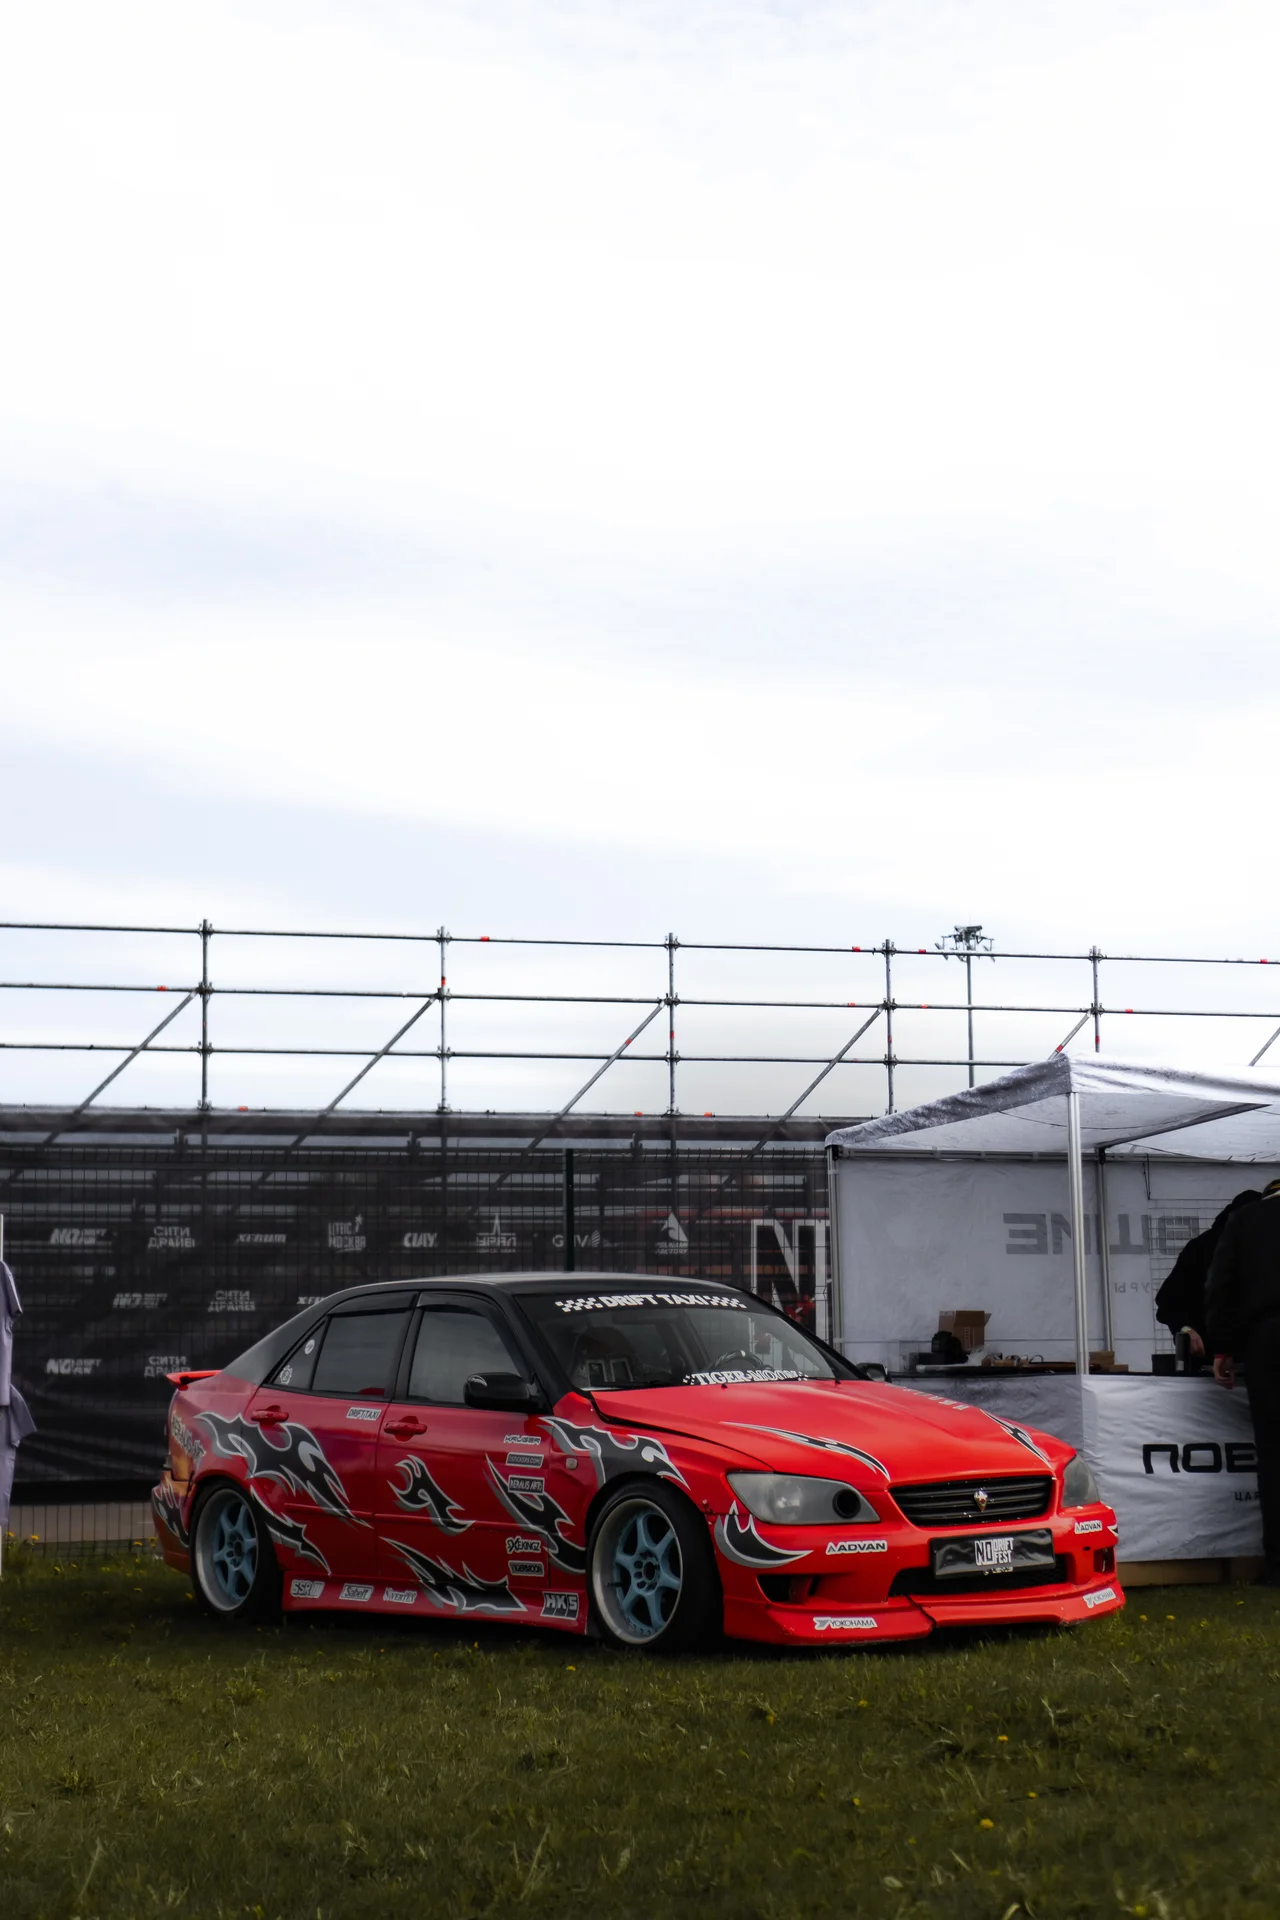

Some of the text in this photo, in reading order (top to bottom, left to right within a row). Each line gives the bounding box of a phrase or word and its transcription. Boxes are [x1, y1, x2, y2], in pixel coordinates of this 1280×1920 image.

[600, 1294, 710, 1307] DRIFT TAXI
[1080, 1521, 1102, 1532] ADVAN
[837, 1542, 886, 1552] ADVAN
[974, 1537, 1014, 1566] NO DRIFT
[993, 1550, 1012, 1564] FEST
[545, 1594, 578, 1610] HKS
[831, 1619, 877, 1628] YOKOHAMA
